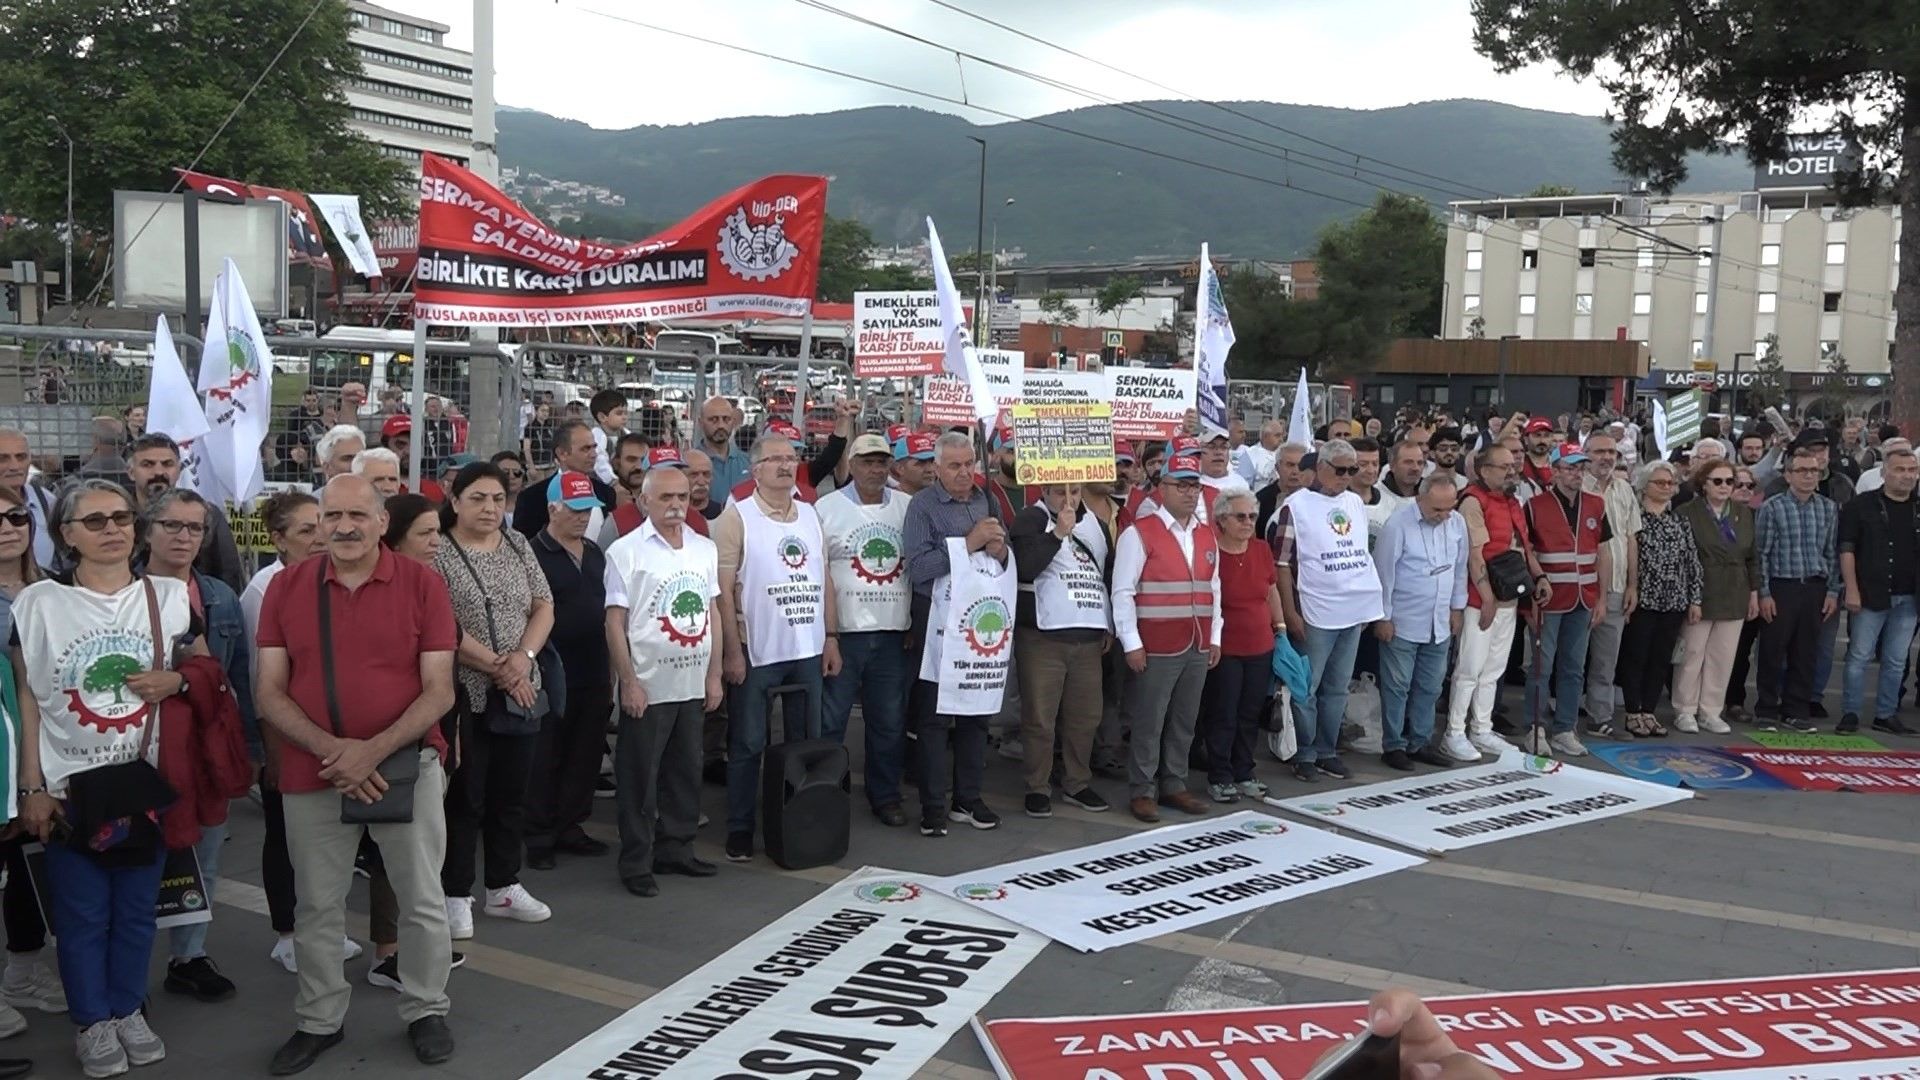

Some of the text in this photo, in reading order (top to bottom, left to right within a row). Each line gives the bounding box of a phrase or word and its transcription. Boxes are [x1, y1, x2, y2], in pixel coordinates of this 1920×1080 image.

[1768, 156, 1837, 176] HOTEL
[417, 251, 510, 288] BİRLİKTE
[590, 258, 705, 286] DURALIM!
[864, 295, 941, 308] EMEKLİLERİ
[415, 309, 520, 323] ULUSLARARASI
[525, 307, 551, 326] İŞÇİ
[554, 304, 648, 322] DAYANIŞMASI
[655, 299, 708, 315] DERNEĞİ
[892, 309, 918, 318] YOK
[859, 331, 915, 344] BİRLİKTE
[859, 344, 897, 355] KARŞI
[927, 381, 972, 393] BİRLİKT
[1115, 373, 1177, 388] SENDİKAL
[927, 394, 963, 405] KARŞI
[1115, 386, 1185, 400] BASKILARA
[1037, 465, 1083, 482] Sendikam
[788, 573, 809, 583] TÜM
[107, 705, 129, 716] 2017
[1340, 769, 1542, 811] TÜM EMEKLİLERİN
[1426, 787, 1553, 816] SENDİKASI
[1433, 808, 1563, 839] MUDANYA
[1004, 829, 1257, 891] TÜM EMEKLİLERİN
[1106, 853, 1262, 897] SENDİKASI
[1082, 853, 1374, 934] KESTEL TEMSİLCİLİĞİ
[752, 908, 886, 978] SENDİKASI
[810, 917, 1020, 1029] ŞUBESİ
[1054, 1021, 1355, 1057] ZAMLARA,
